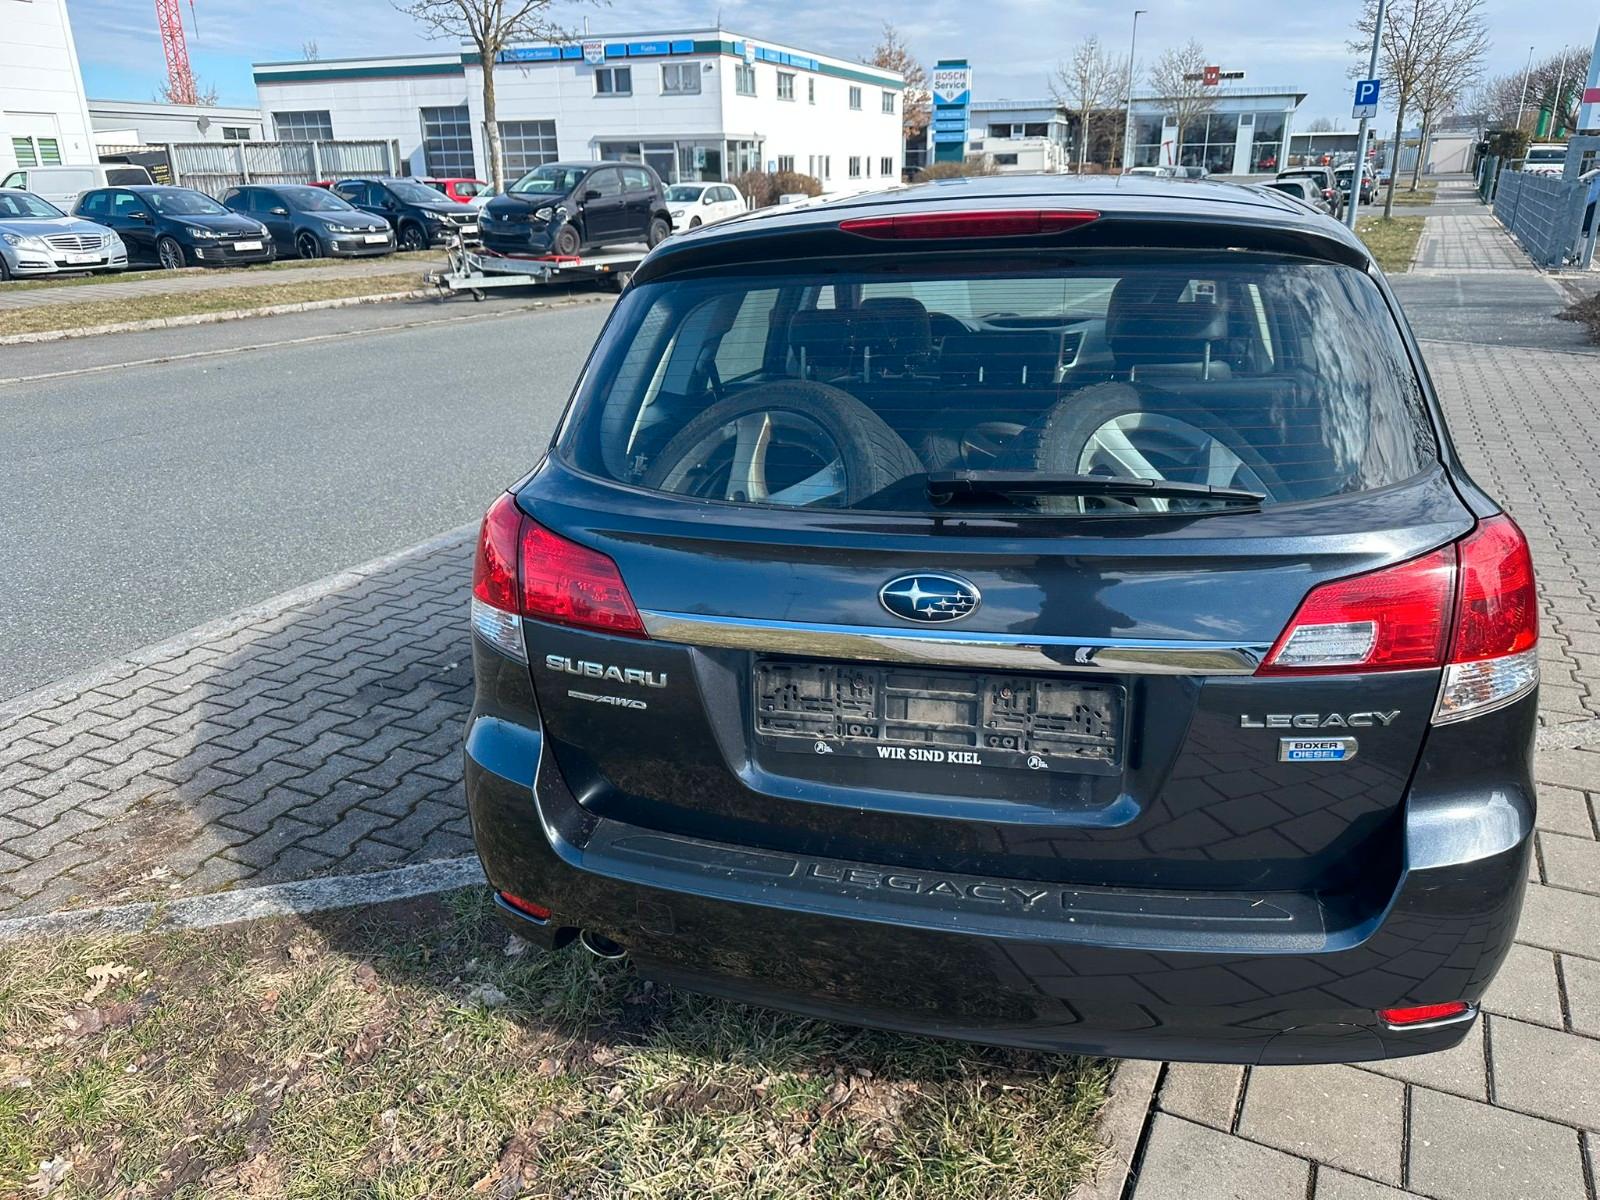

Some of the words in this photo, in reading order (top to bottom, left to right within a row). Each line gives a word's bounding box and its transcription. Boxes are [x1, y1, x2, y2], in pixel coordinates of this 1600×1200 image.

[934, 81, 966, 89] Service
[935, 72, 966, 80] BOSCH
[1360, 84, 1374, 102] P
[545, 654, 667, 688] SUBARU
[596, 695, 647, 710] AWD
[1240, 710, 1401, 728] LEGACY
[876, 746, 906, 760] WIR
[908, 748, 945, 762] SIND
[947, 751, 982, 765] KIEL
[1292, 750, 1338, 758] DIESEL
[806, 863, 1048, 907] LEGACY
